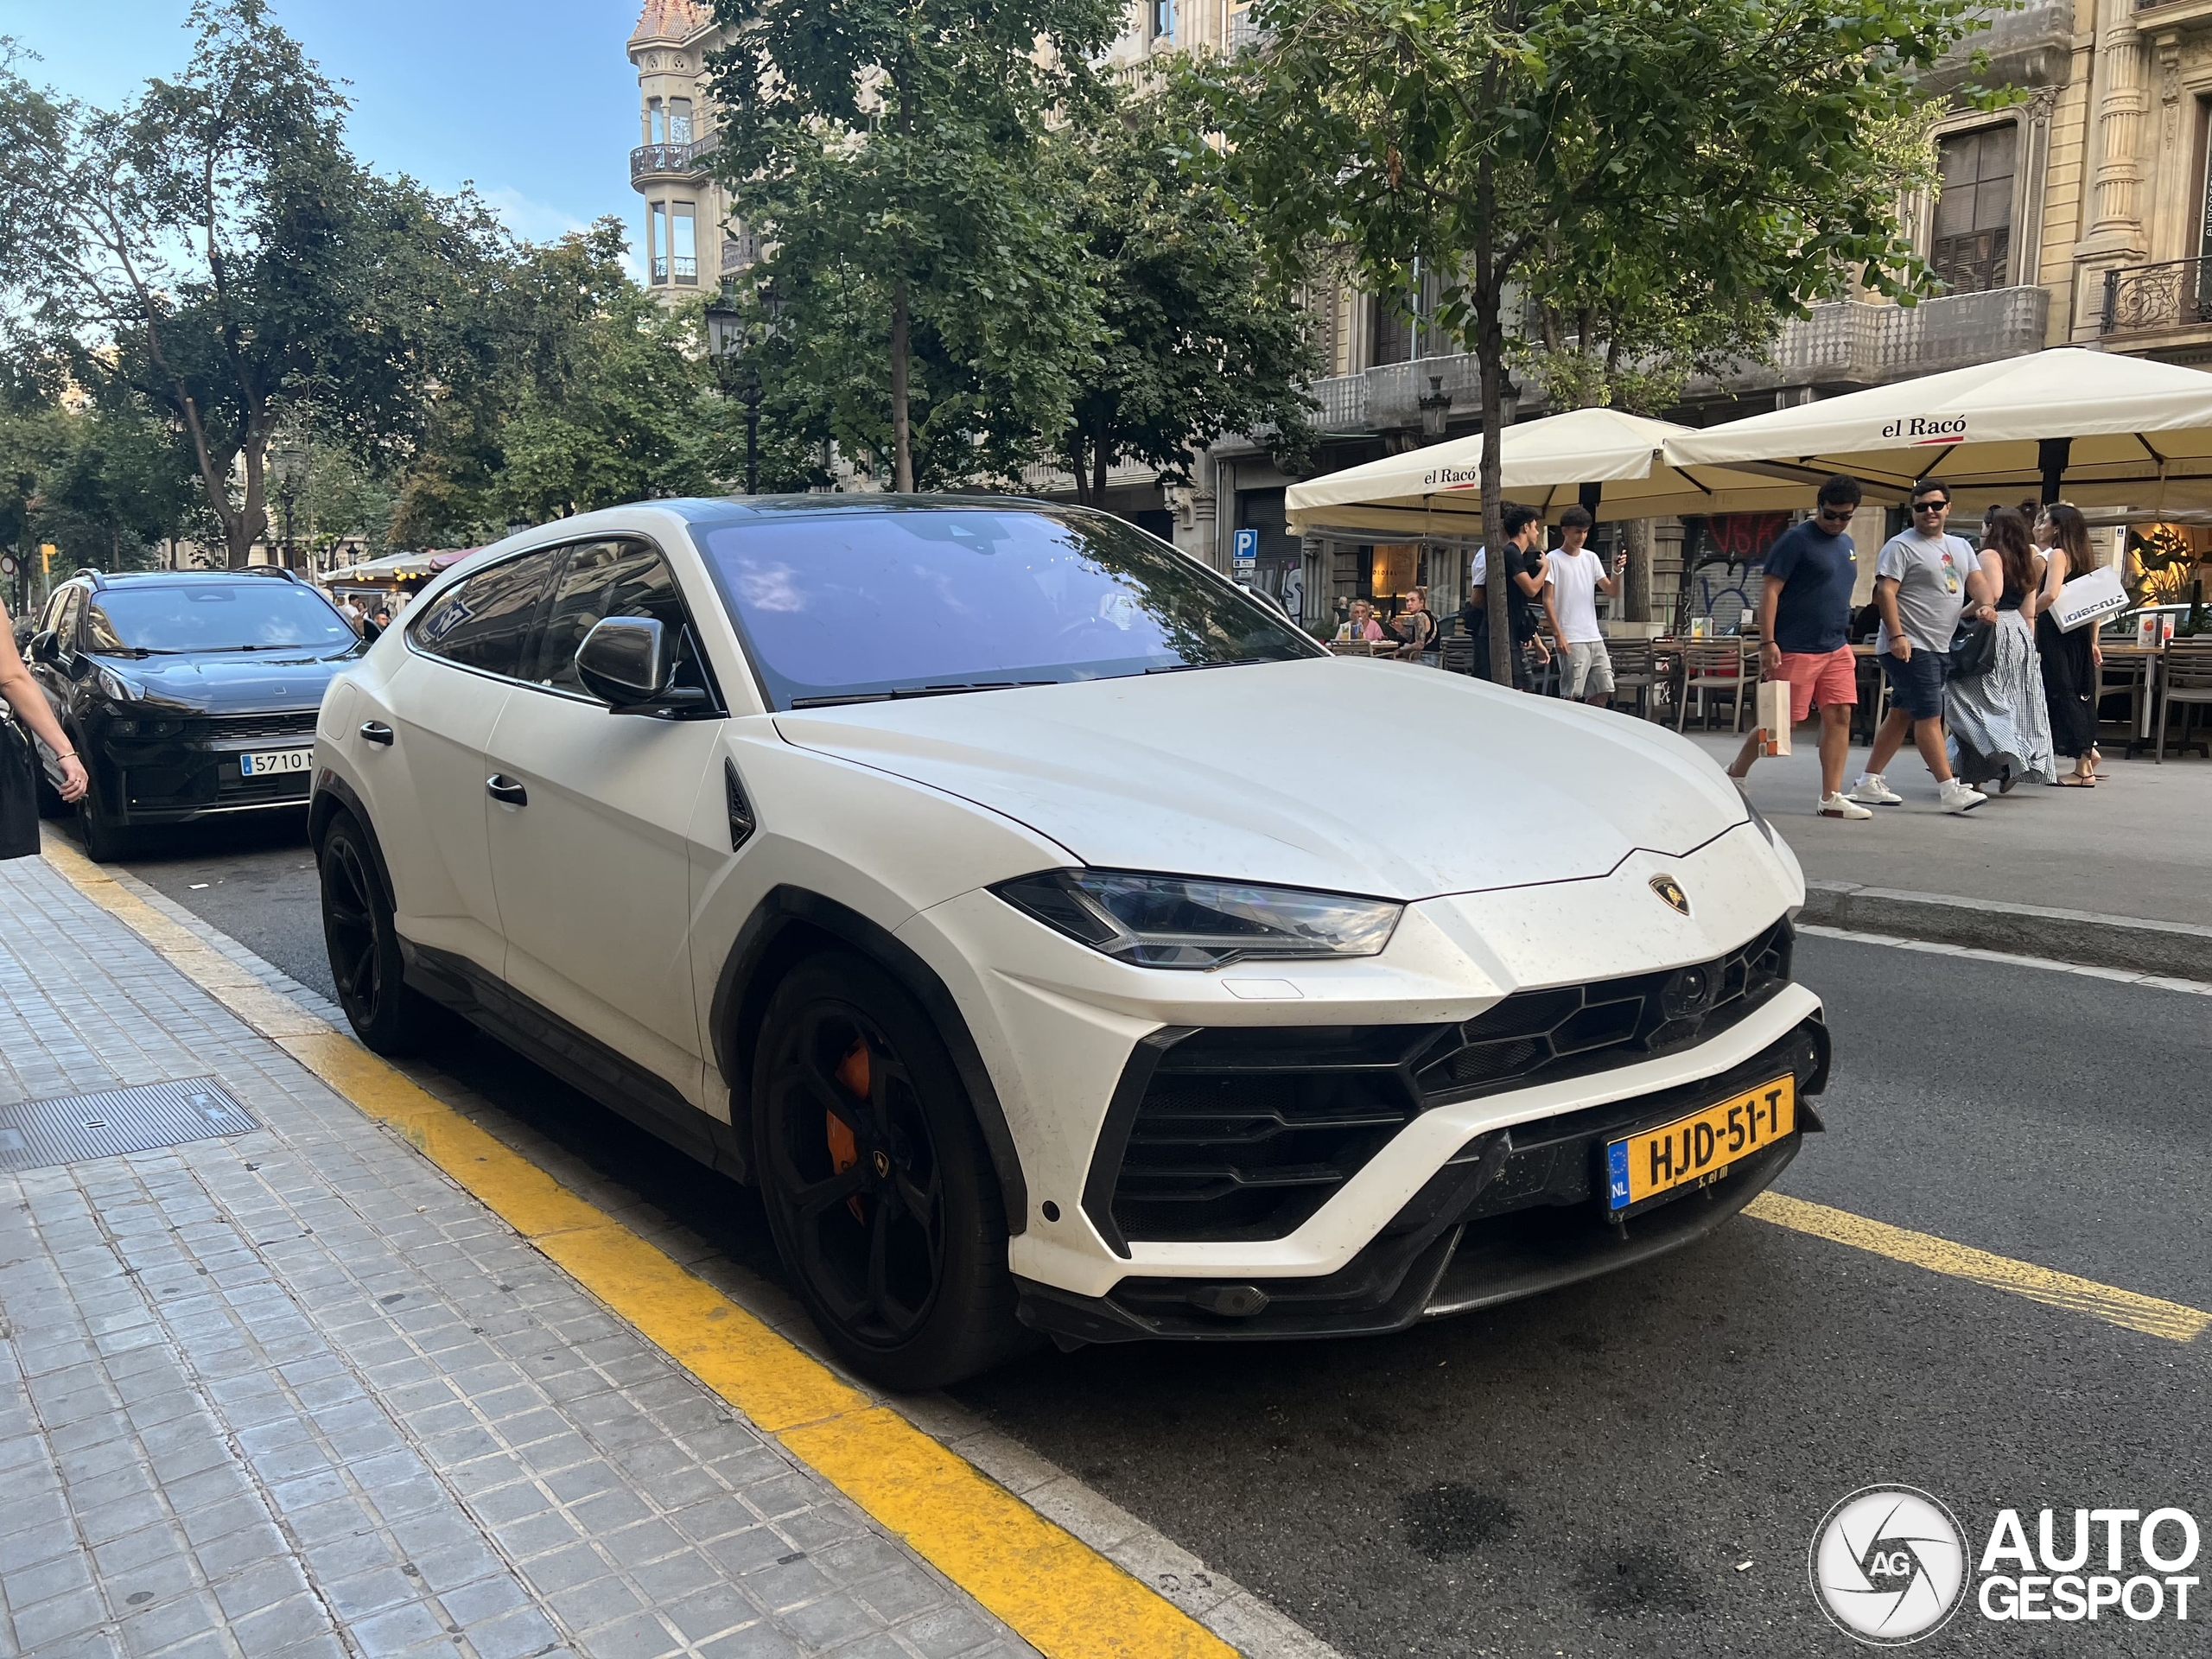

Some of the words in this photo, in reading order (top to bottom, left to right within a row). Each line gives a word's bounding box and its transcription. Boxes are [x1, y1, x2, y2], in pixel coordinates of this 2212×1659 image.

[1882, 419, 1902, 438] el
[1908, 414, 1967, 436] Racó
[1424, 470, 1437, 485] el
[1440, 466, 1476, 483] Racó
[1237, 533, 1252, 556] P
[255, 753, 302, 772] 5710
[1649, 1089, 1783, 1186] HJD-51-T
[1612, 1181, 1628, 1198] NL
